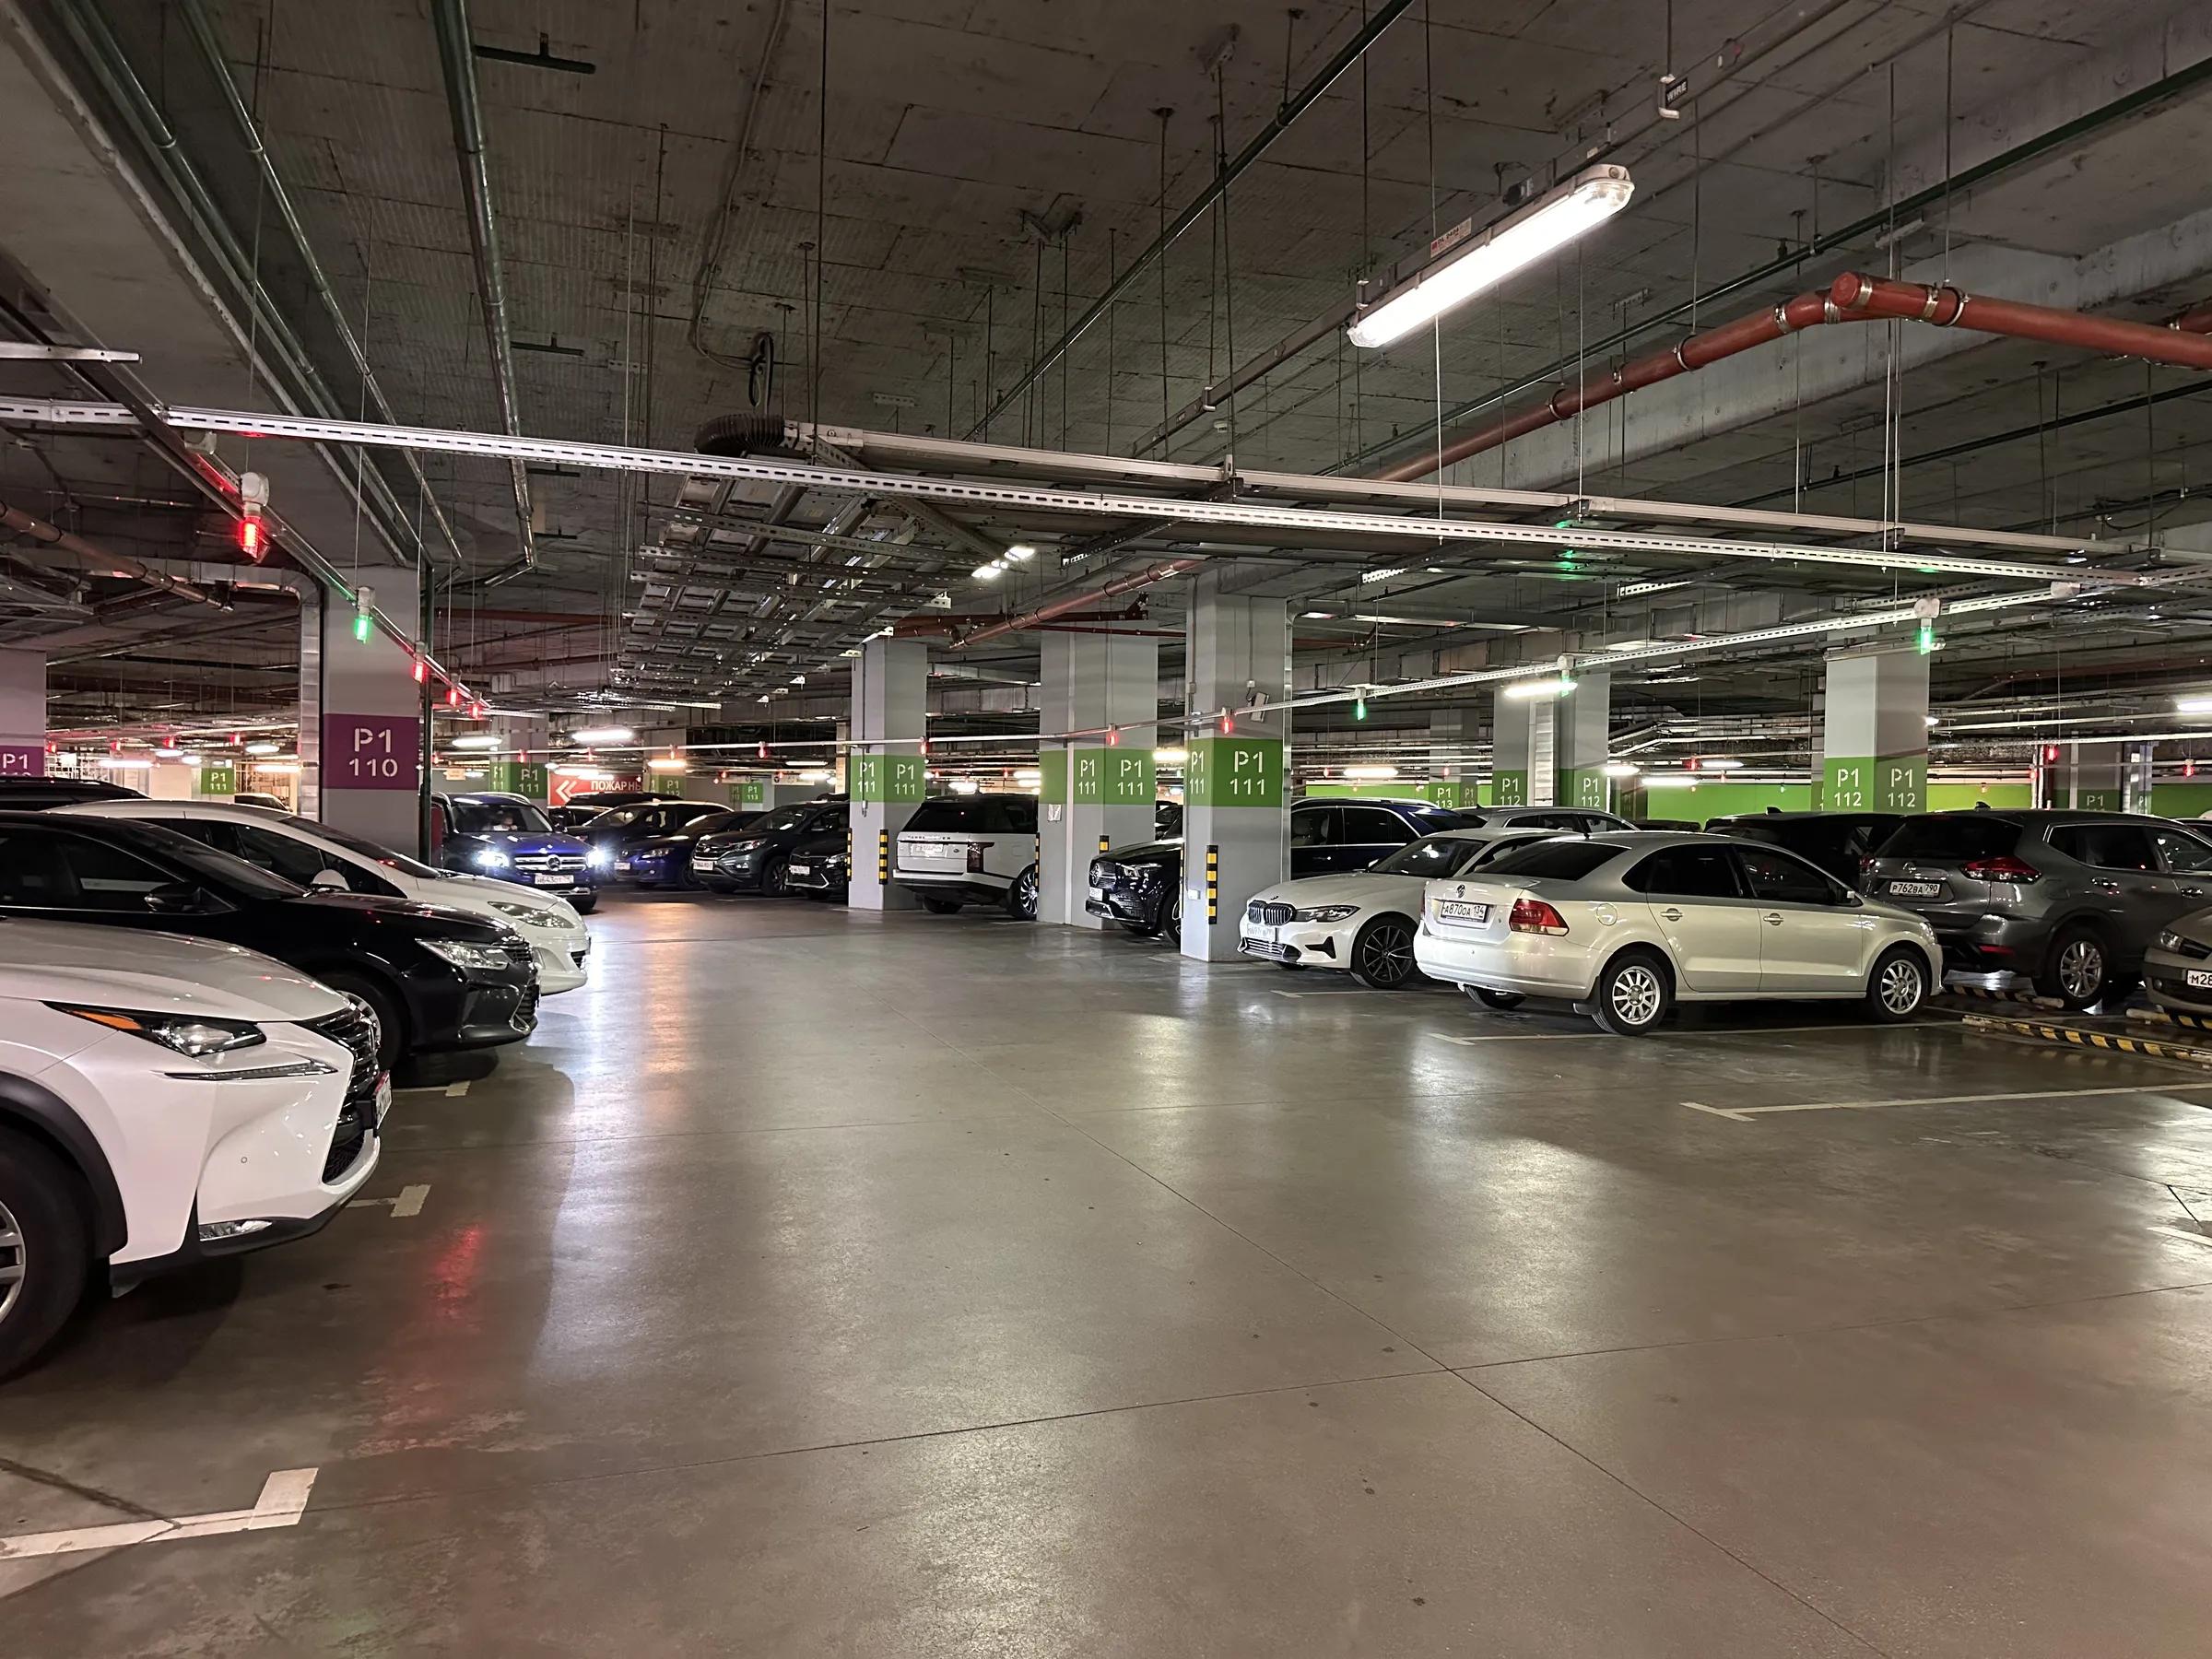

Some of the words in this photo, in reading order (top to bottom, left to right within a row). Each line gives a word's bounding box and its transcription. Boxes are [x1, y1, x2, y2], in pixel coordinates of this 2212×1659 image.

[1666, 81, 1687, 101] WIRE
[354, 728, 392, 753] P1
[3, 753, 28, 770] P1
[348, 758, 398, 777] 110
[1080, 759, 1095, 778] P1
[1121, 759, 1142, 778] P1
[1192, 750, 1204, 773] P1
[1234, 750, 1263, 773] P1
[211, 772, 226, 782] P1
[859, 761, 875, 778] P1
[897, 763, 914, 780] P1
[667, 780, 679, 789] P1
[1501, 778, 1519, 793] P1
[1583, 777, 1598, 793] P1
[1837, 768, 1859, 788] P1
[1890, 768, 1913, 788] P1
[518, 783, 539, 793] 111
[857, 781, 876, 793] 111
[894, 782, 915, 795] 111
[1078, 781, 1096, 795] 111
[1117, 782, 1143, 795] 111
[1189, 778, 1205, 794] 111
[1230, 778, 1265, 795] 111
[1437, 787, 1452, 798] P1
[1465, 788, 1475, 798] P1
[1435, 799, 1453, 809] 113
[1500, 794, 1521, 806] 112
[1581, 795, 1600, 807] 112
[1834, 791, 1862, 806] 112
[1888, 792, 1916, 807] 112
[2087, 794, 2103, 806] P1
[1925, 884, 1938, 892] 790
[1473, 905, 1485, 915] 134
